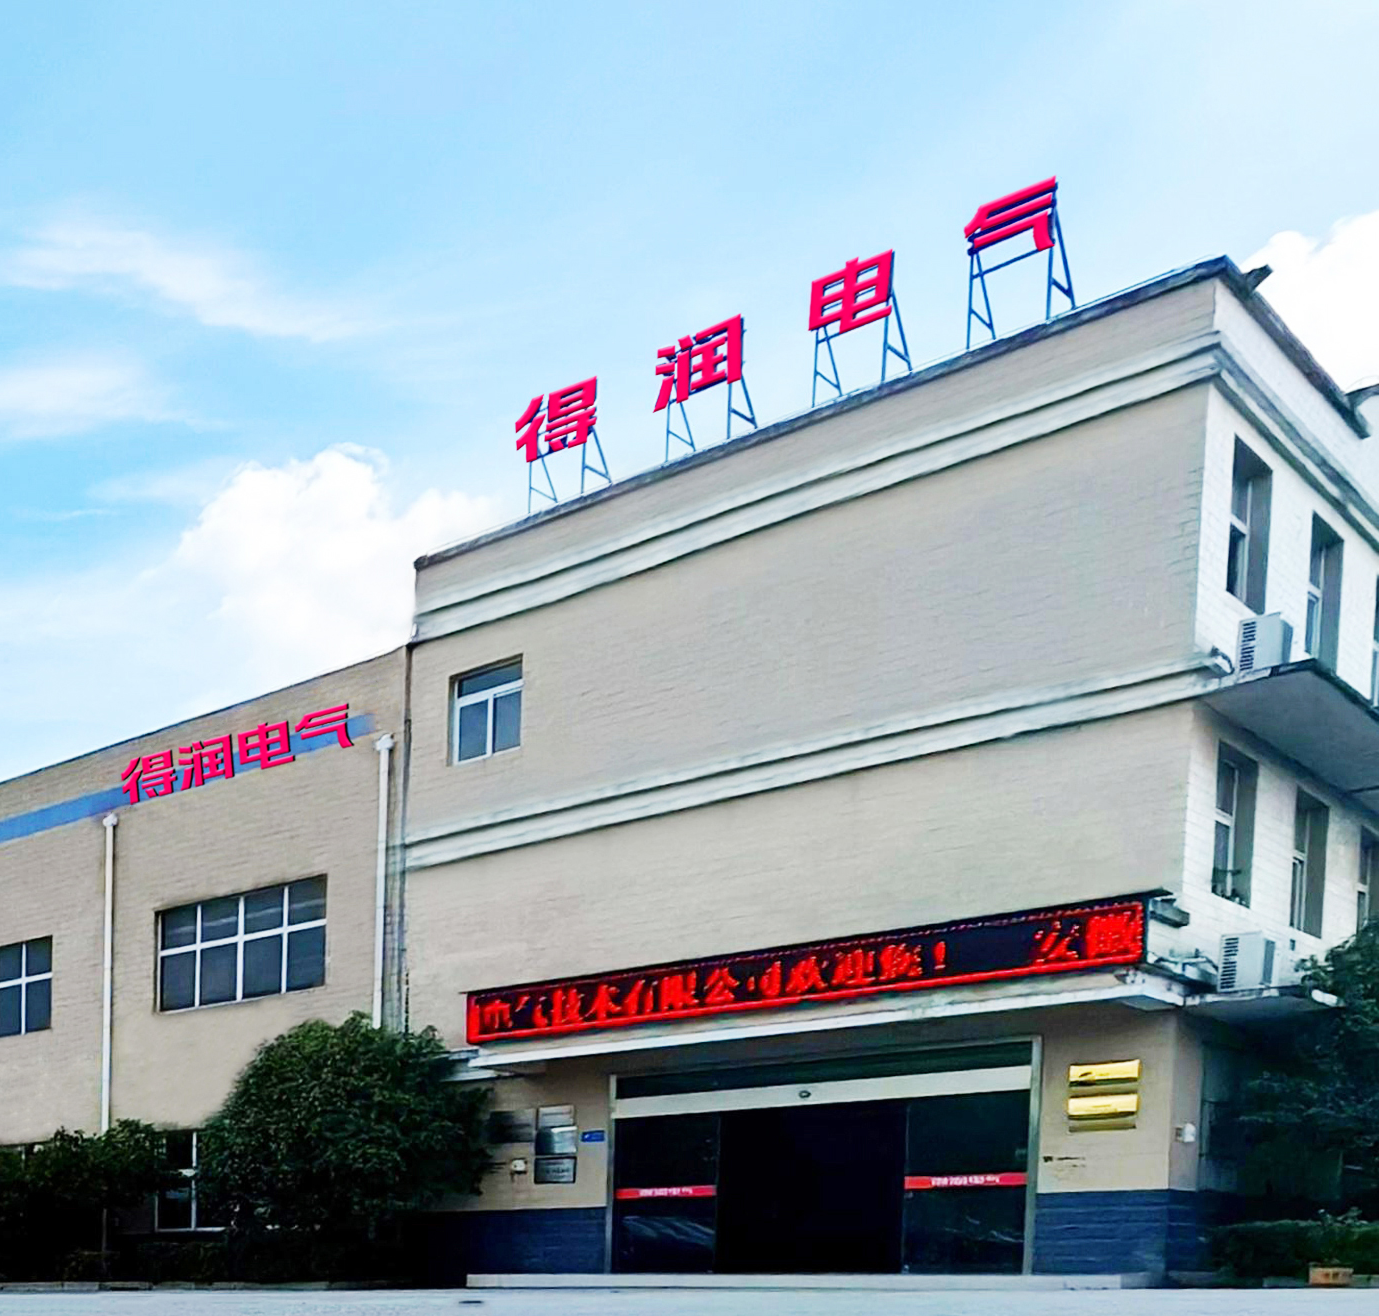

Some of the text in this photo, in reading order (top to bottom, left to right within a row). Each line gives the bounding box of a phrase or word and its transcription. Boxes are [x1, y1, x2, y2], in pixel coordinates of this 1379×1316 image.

[515, 175, 1057, 463] 得润电气
[120, 702, 354, 805] 得润电气
